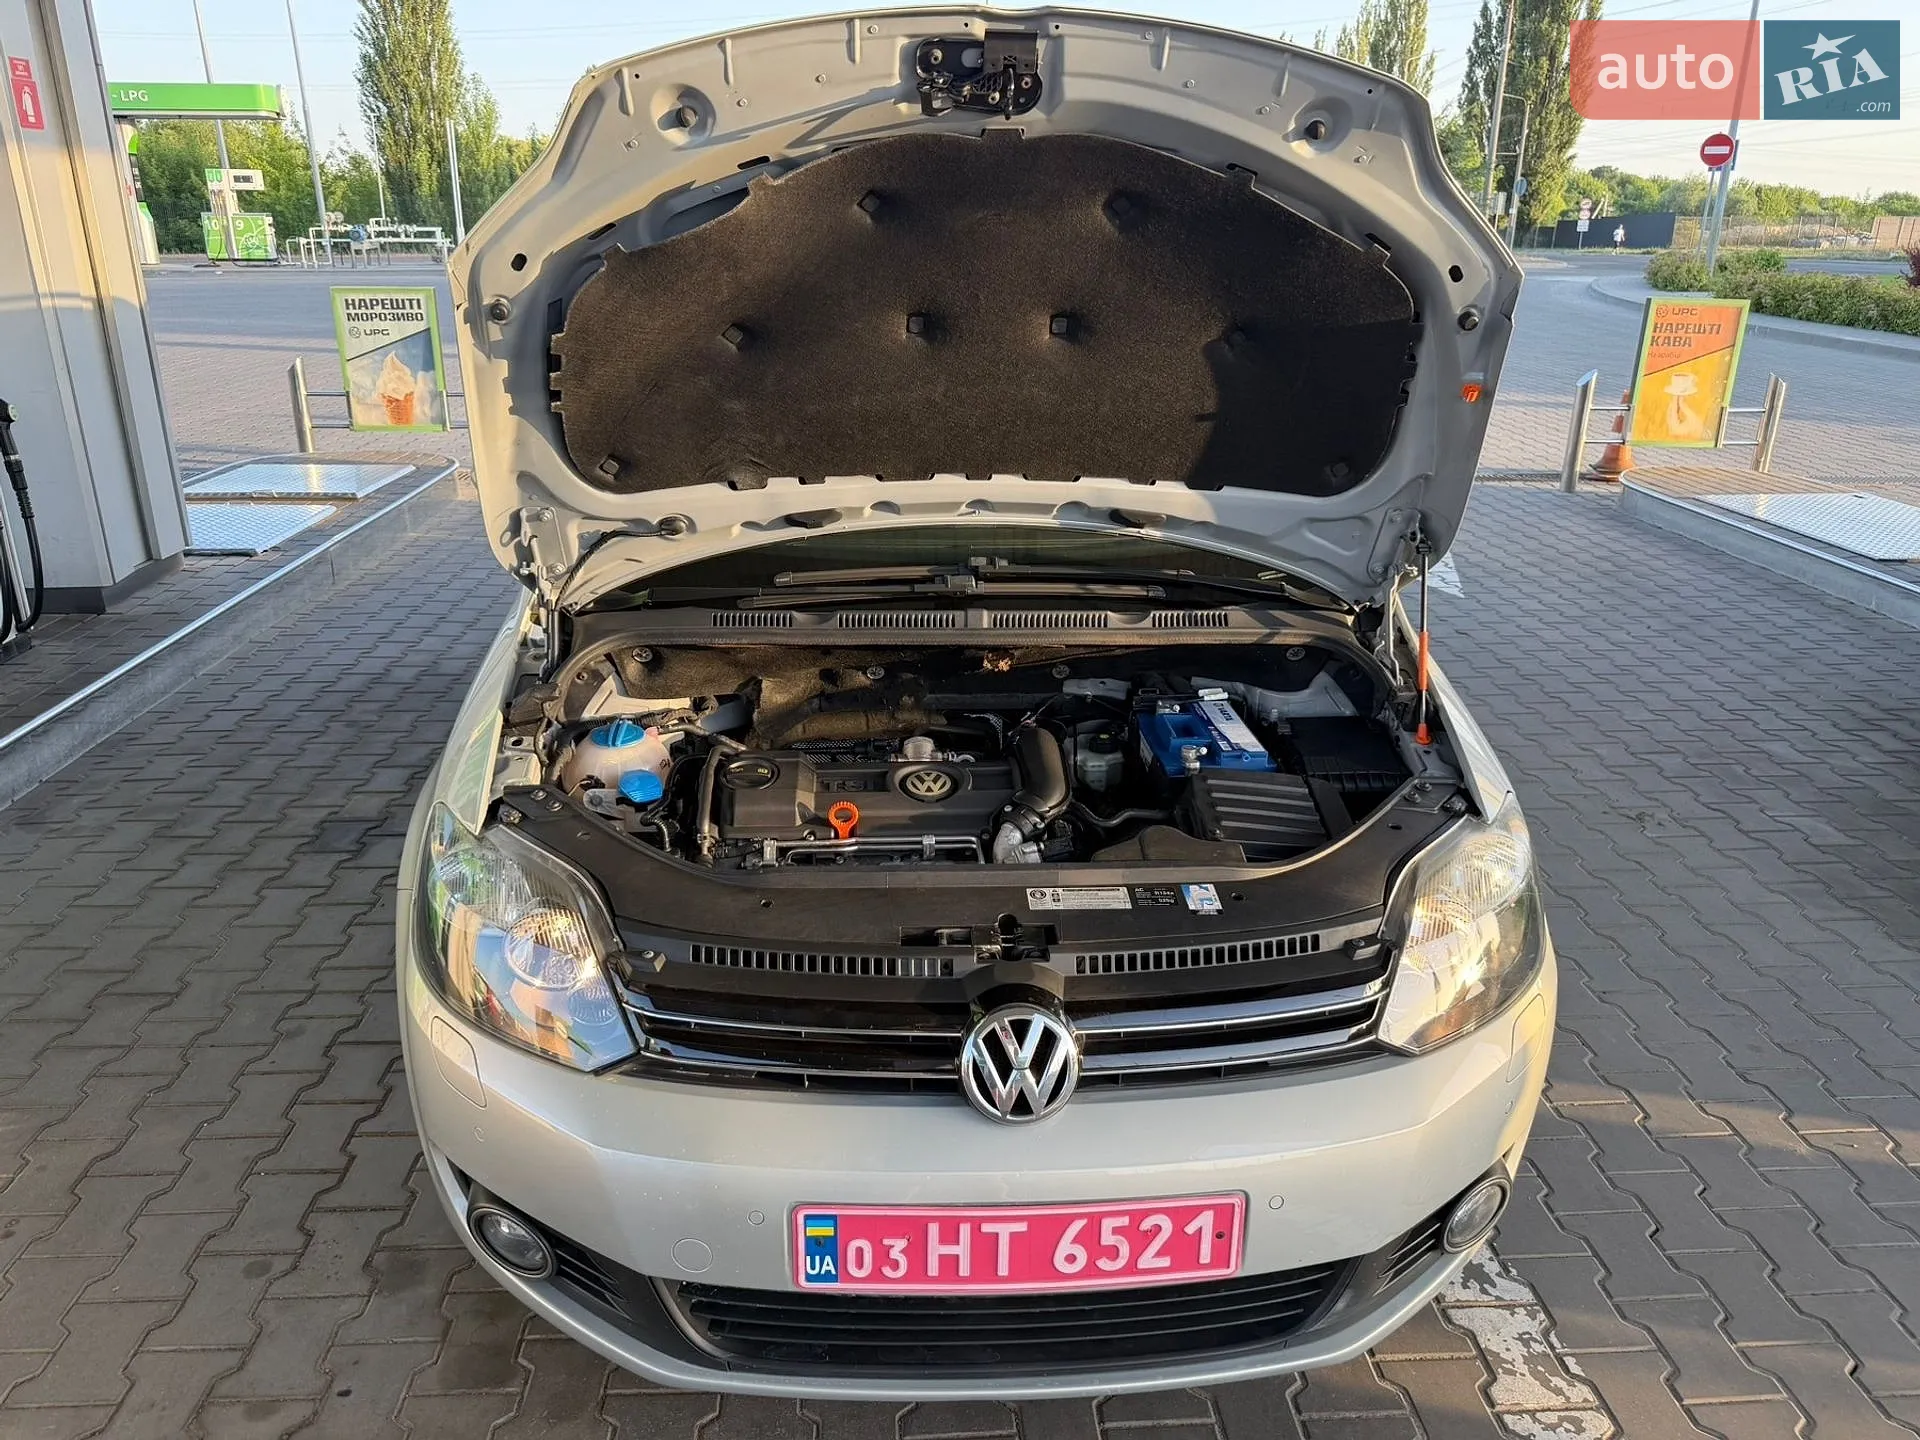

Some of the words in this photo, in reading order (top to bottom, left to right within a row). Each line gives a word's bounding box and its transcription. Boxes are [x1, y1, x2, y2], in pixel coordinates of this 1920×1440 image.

[120, 90, 149, 102] LPG
[344, 298, 423, 311] НАРЕШТІ
[346, 312, 424, 322] МОРОЗИВО
[363, 328, 390, 336] UPG
[1653, 322, 1722, 335] НАРЕШТІ
[1650, 335, 1693, 348] КАВА
[846, 1238, 909, 1279] 03
[925, 1221, 1029, 1278] HT
[1052, 1209, 1217, 1275] 6521
[805, 1255, 837, 1276] UA
